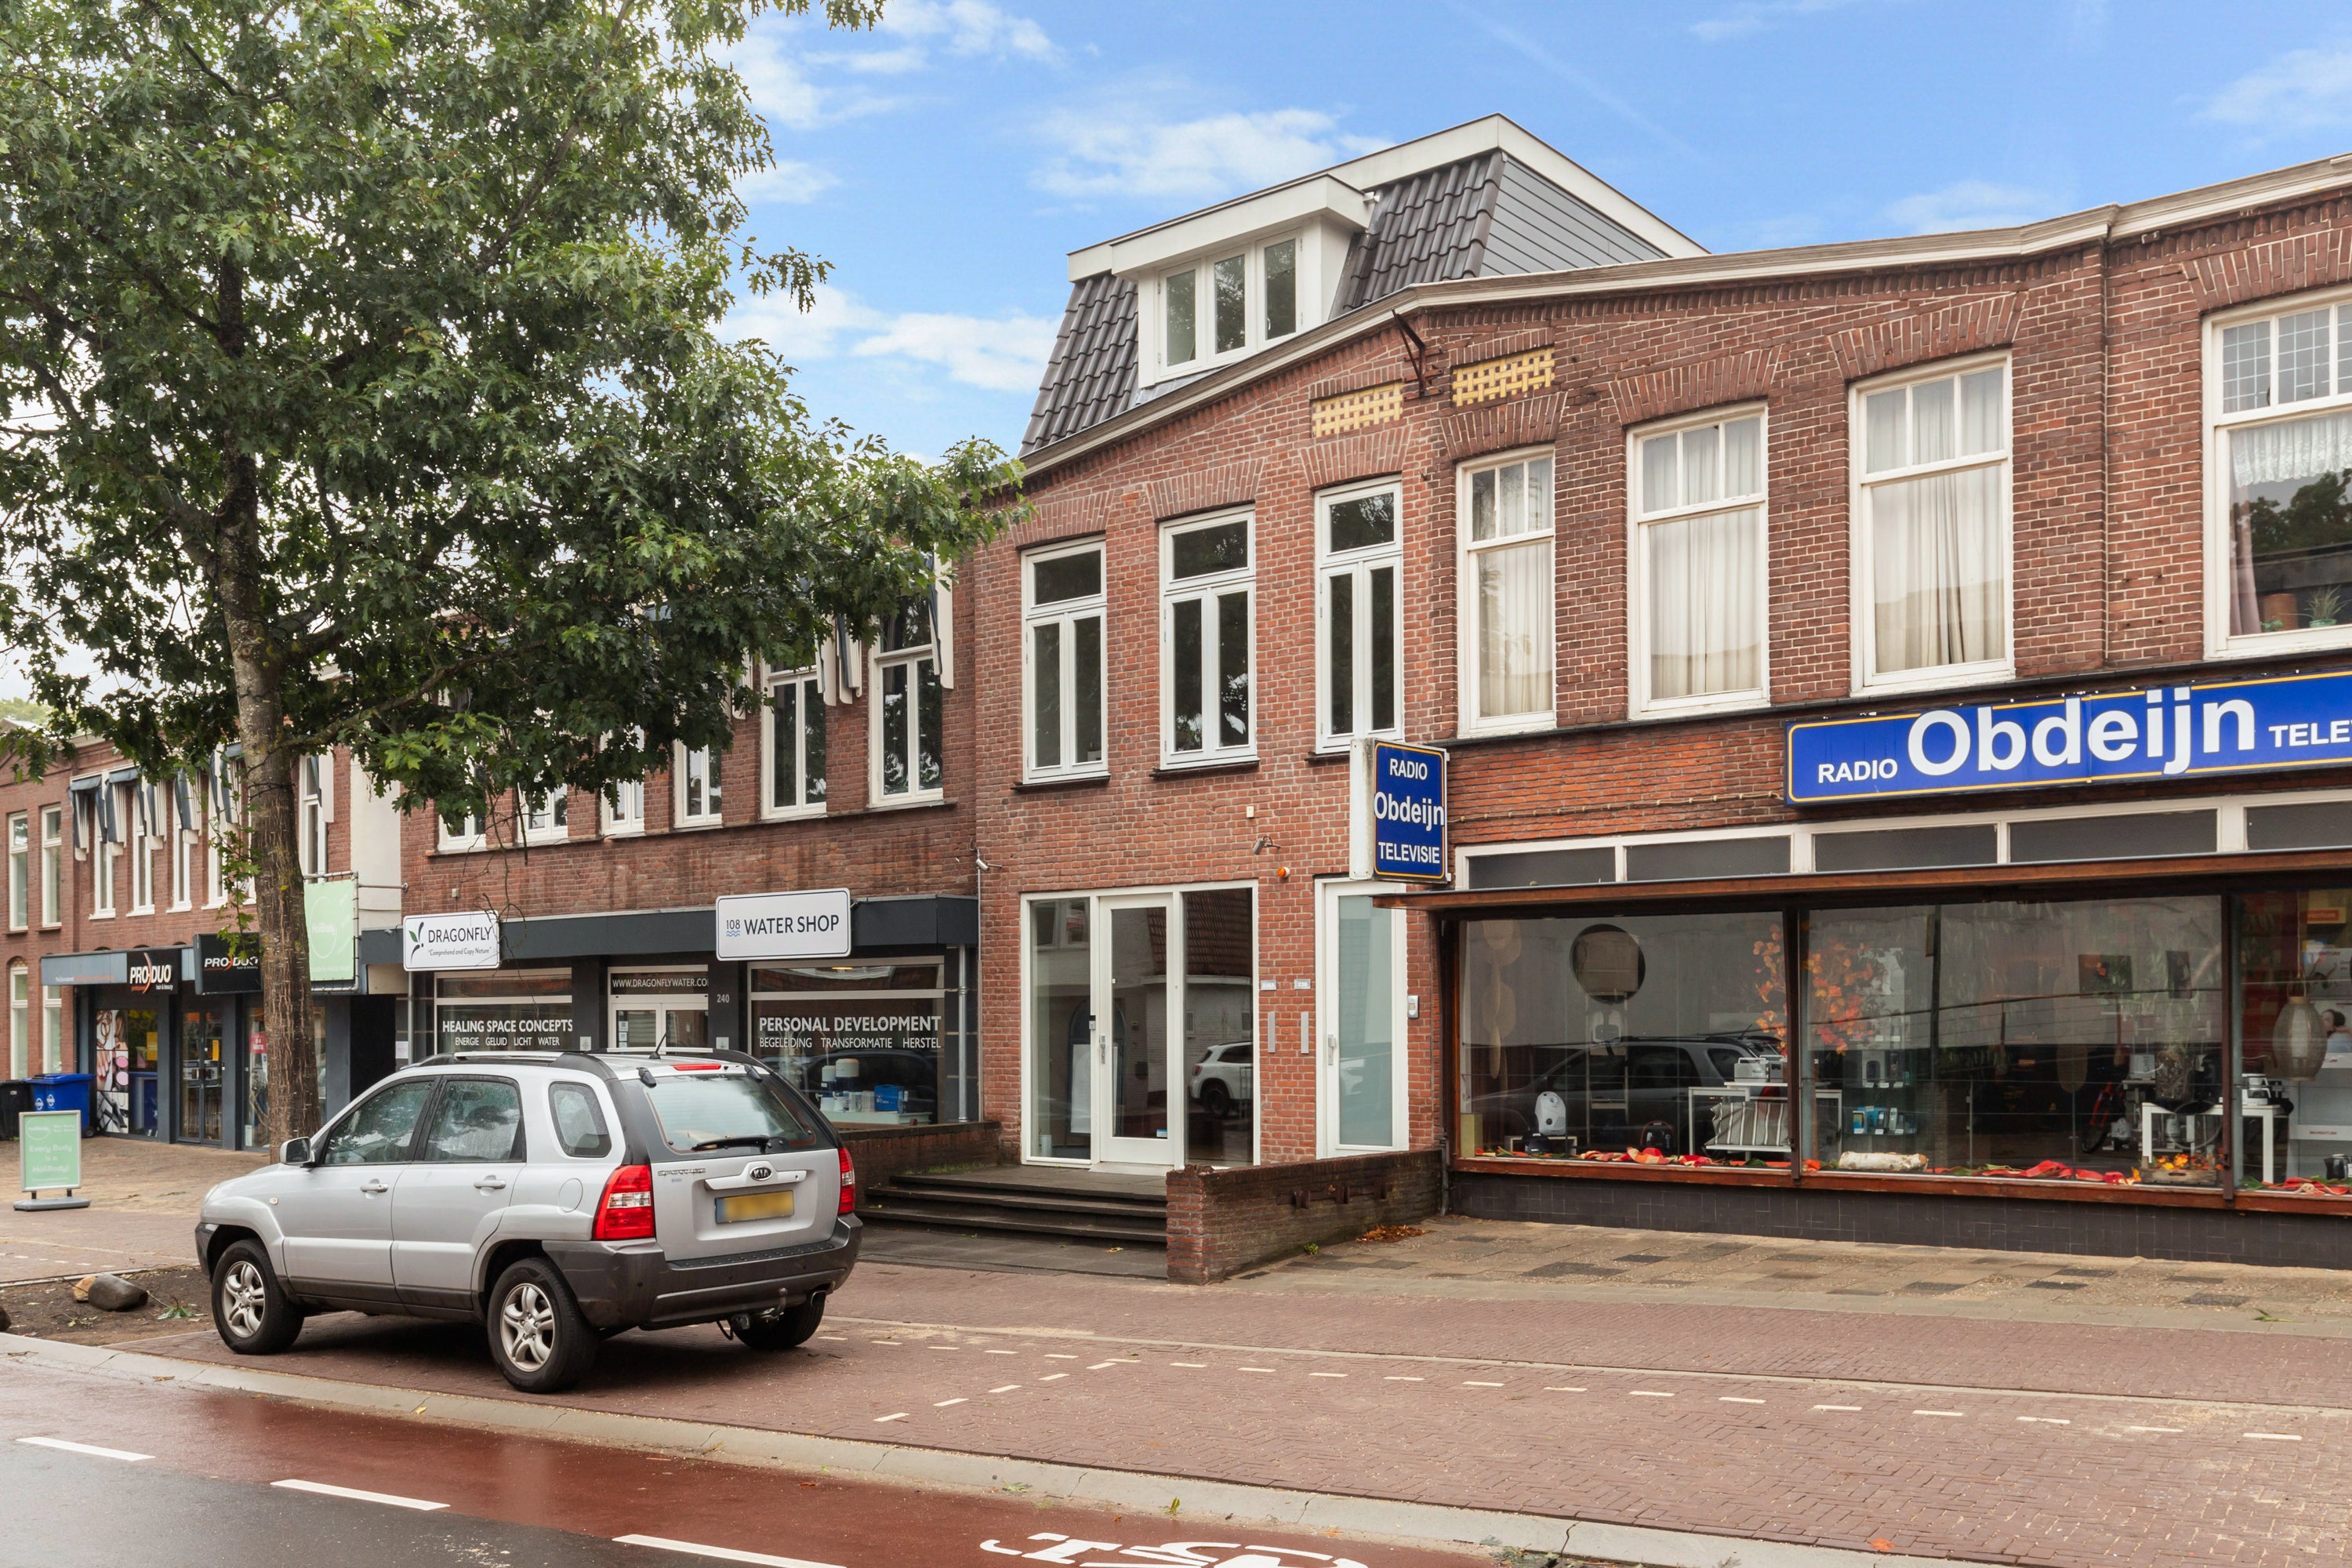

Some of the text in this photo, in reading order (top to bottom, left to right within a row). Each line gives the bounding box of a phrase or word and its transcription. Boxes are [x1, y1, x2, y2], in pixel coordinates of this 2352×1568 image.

[1817, 686, 2352, 784] RADIO Obdeijn TELE
[1389, 757, 1428, 781] RADIO
[1374, 791, 1445, 832] Obdeijn
[1377, 841, 1440, 864] TELEVISIE
[726, 914, 839, 935] 108 WATER SHOP
[428, 926, 492, 943] DRAGONFLY
[463, 947, 474, 956] Copy
[717, 994, 730, 1004] 240
[442, 1019, 573, 1033] HEALING SPACE CONCEPTS
[759, 1015, 941, 1032] PERSONAL DEVELOPMENT
[455, 1036, 560, 1046] ENERGIE GELUID LICHT WATER
[759, 1037, 941, 1048] BEGELEIDING TRANSFORMATIE HERSTEL
[753, 1167, 771, 1179] KIA
